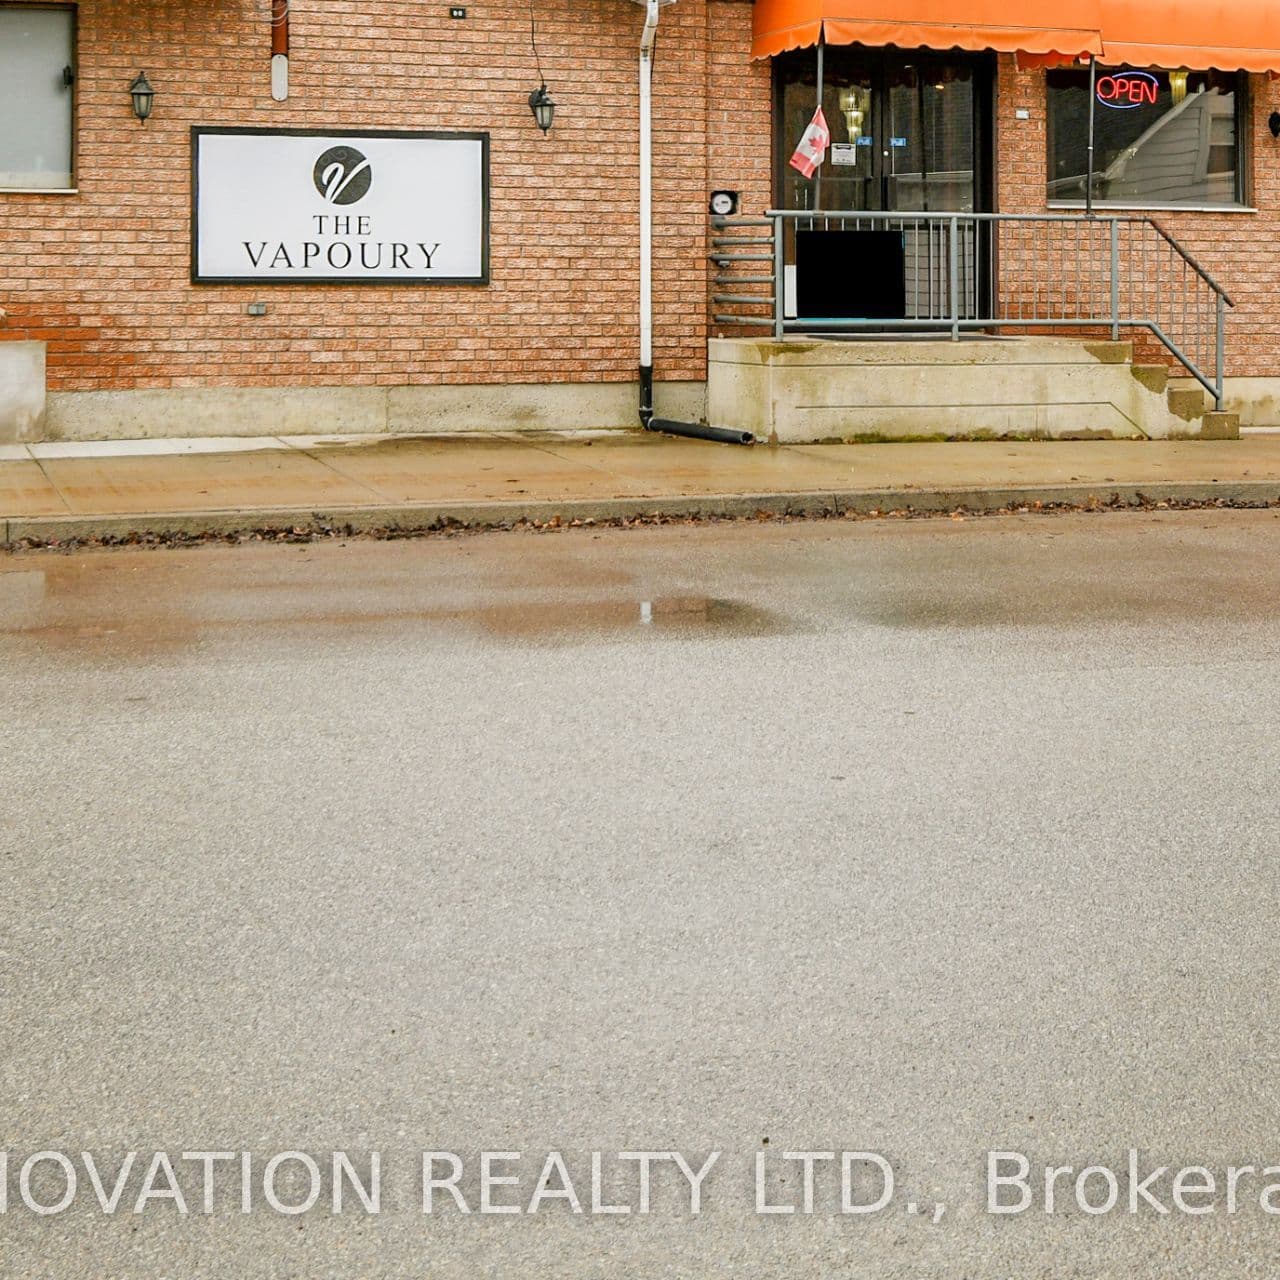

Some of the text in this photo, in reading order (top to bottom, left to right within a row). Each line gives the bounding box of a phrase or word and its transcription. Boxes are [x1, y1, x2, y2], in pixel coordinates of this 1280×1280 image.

[1097, 76, 1157, 104] OPEN
[313, 215, 371, 235] THE
[242, 241, 441, 269] VAPOURY
